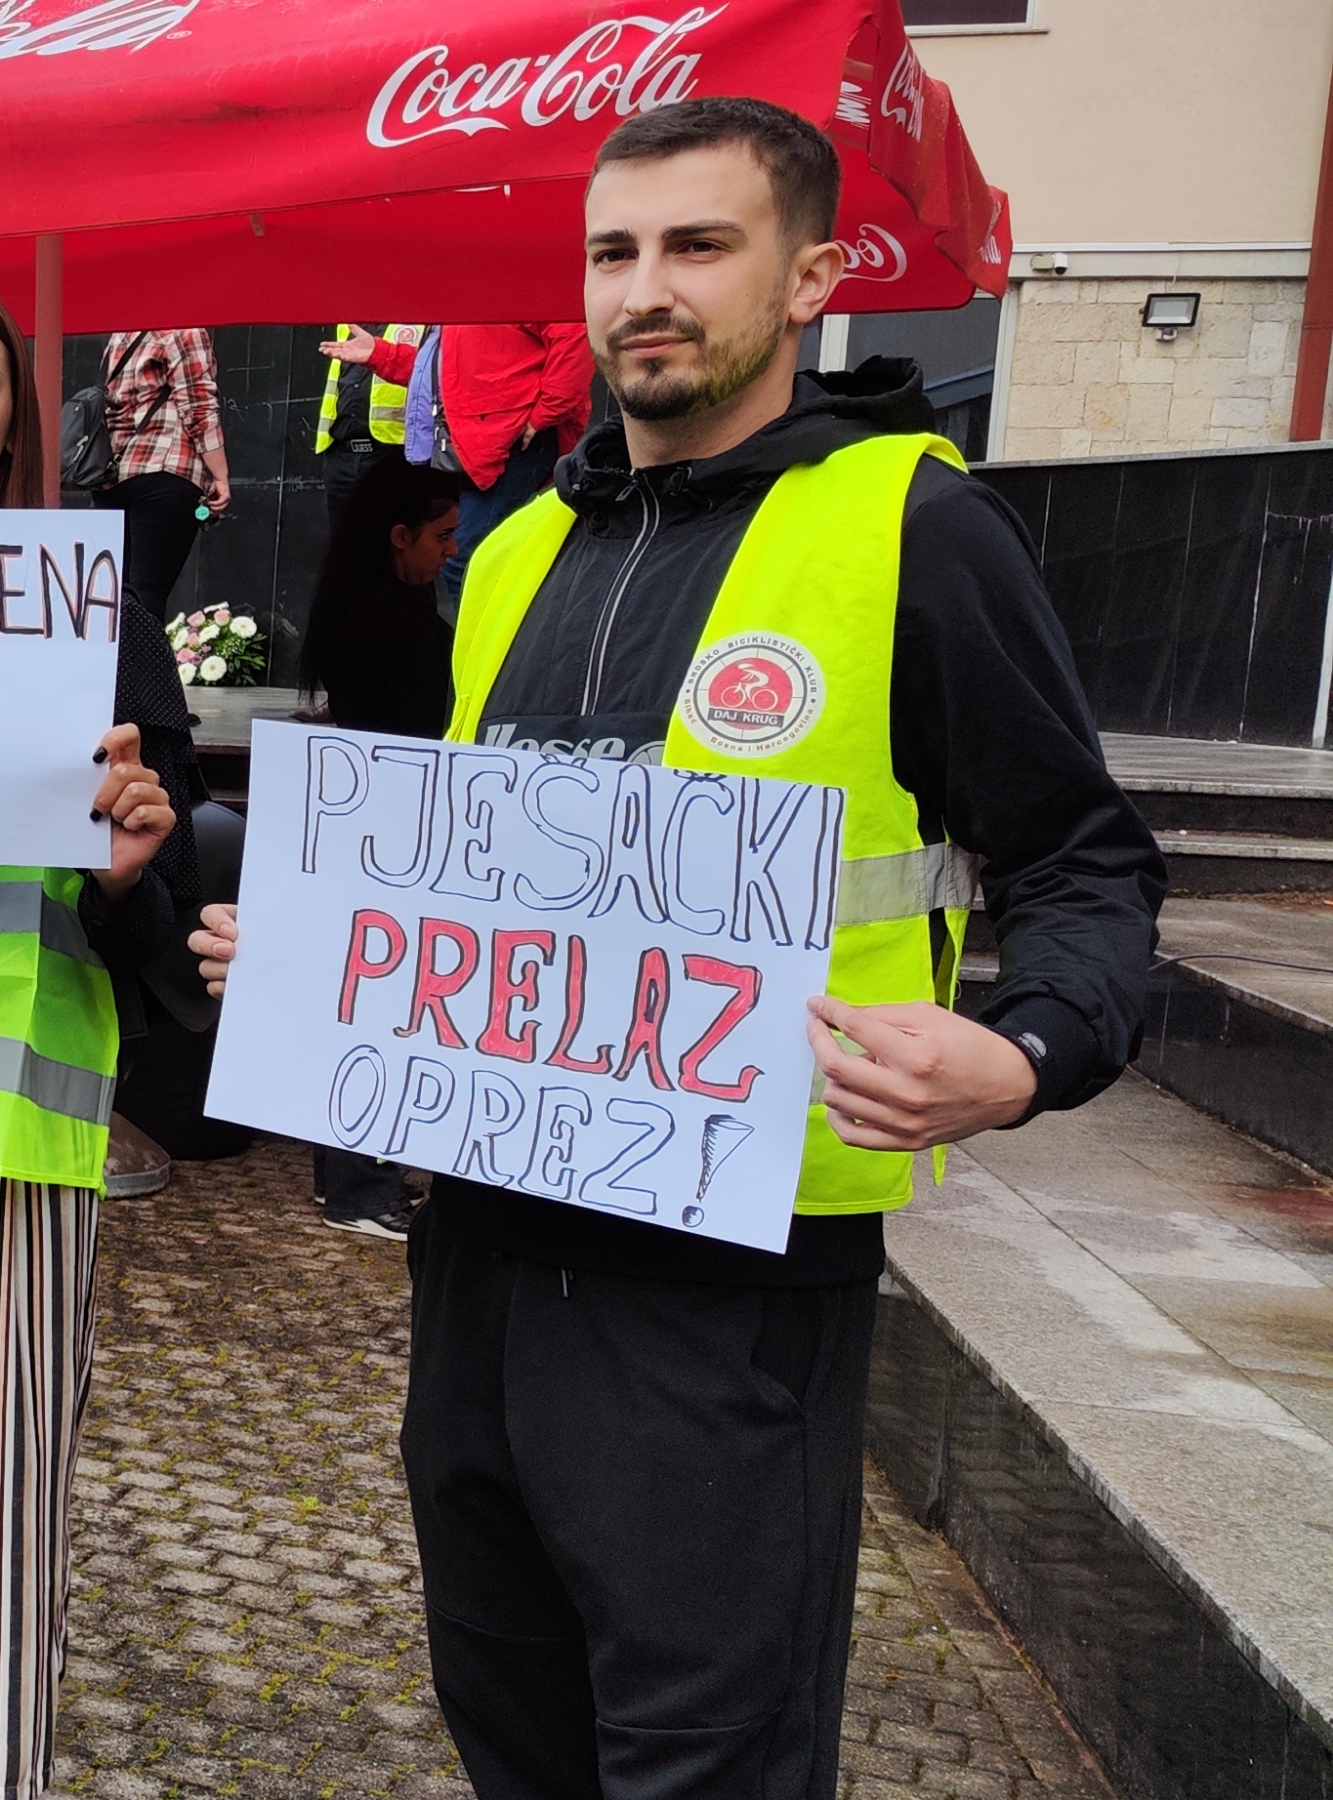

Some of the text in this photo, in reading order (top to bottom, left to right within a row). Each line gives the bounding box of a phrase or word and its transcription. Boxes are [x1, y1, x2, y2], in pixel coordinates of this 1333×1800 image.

[366, 2, 731, 148] Coca-Cola
[688, 635, 818, 694] BRDSKO BICIKLISTIČKI KLUB
[709, 735, 744, 753] Bosna
[756, 708, 814, 752] Hercegovina
[713, 709, 780, 726] DAJ KRUG
[301, 735, 846, 951] PJEŠAČKI
[336, 908, 766, 1103] PRELAZ
